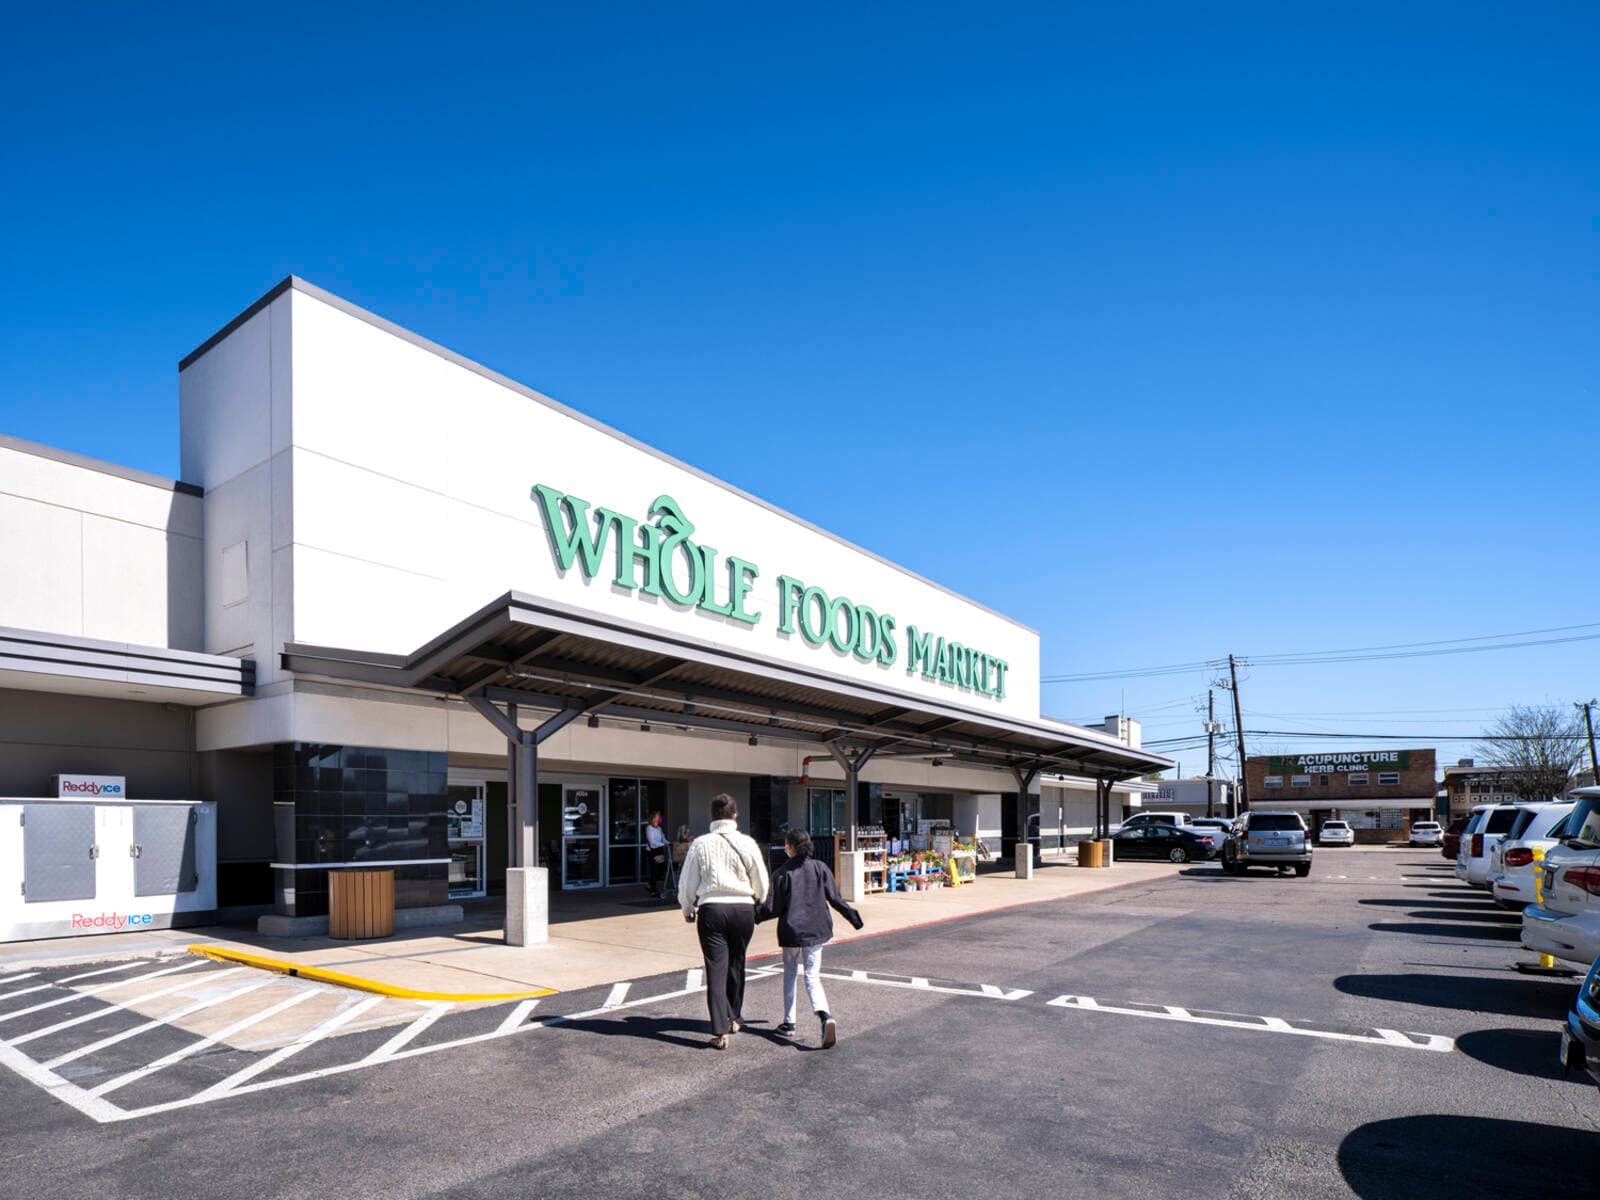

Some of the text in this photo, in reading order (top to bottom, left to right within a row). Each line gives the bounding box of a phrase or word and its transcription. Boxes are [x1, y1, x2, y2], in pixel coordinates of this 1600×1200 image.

[531, 483, 1009, 700] WHOLE FOODS MARKET
[1297, 751, 1399, 766] ACUPUNCTURE
[1304, 763, 1369, 774] HERB CLINIC
